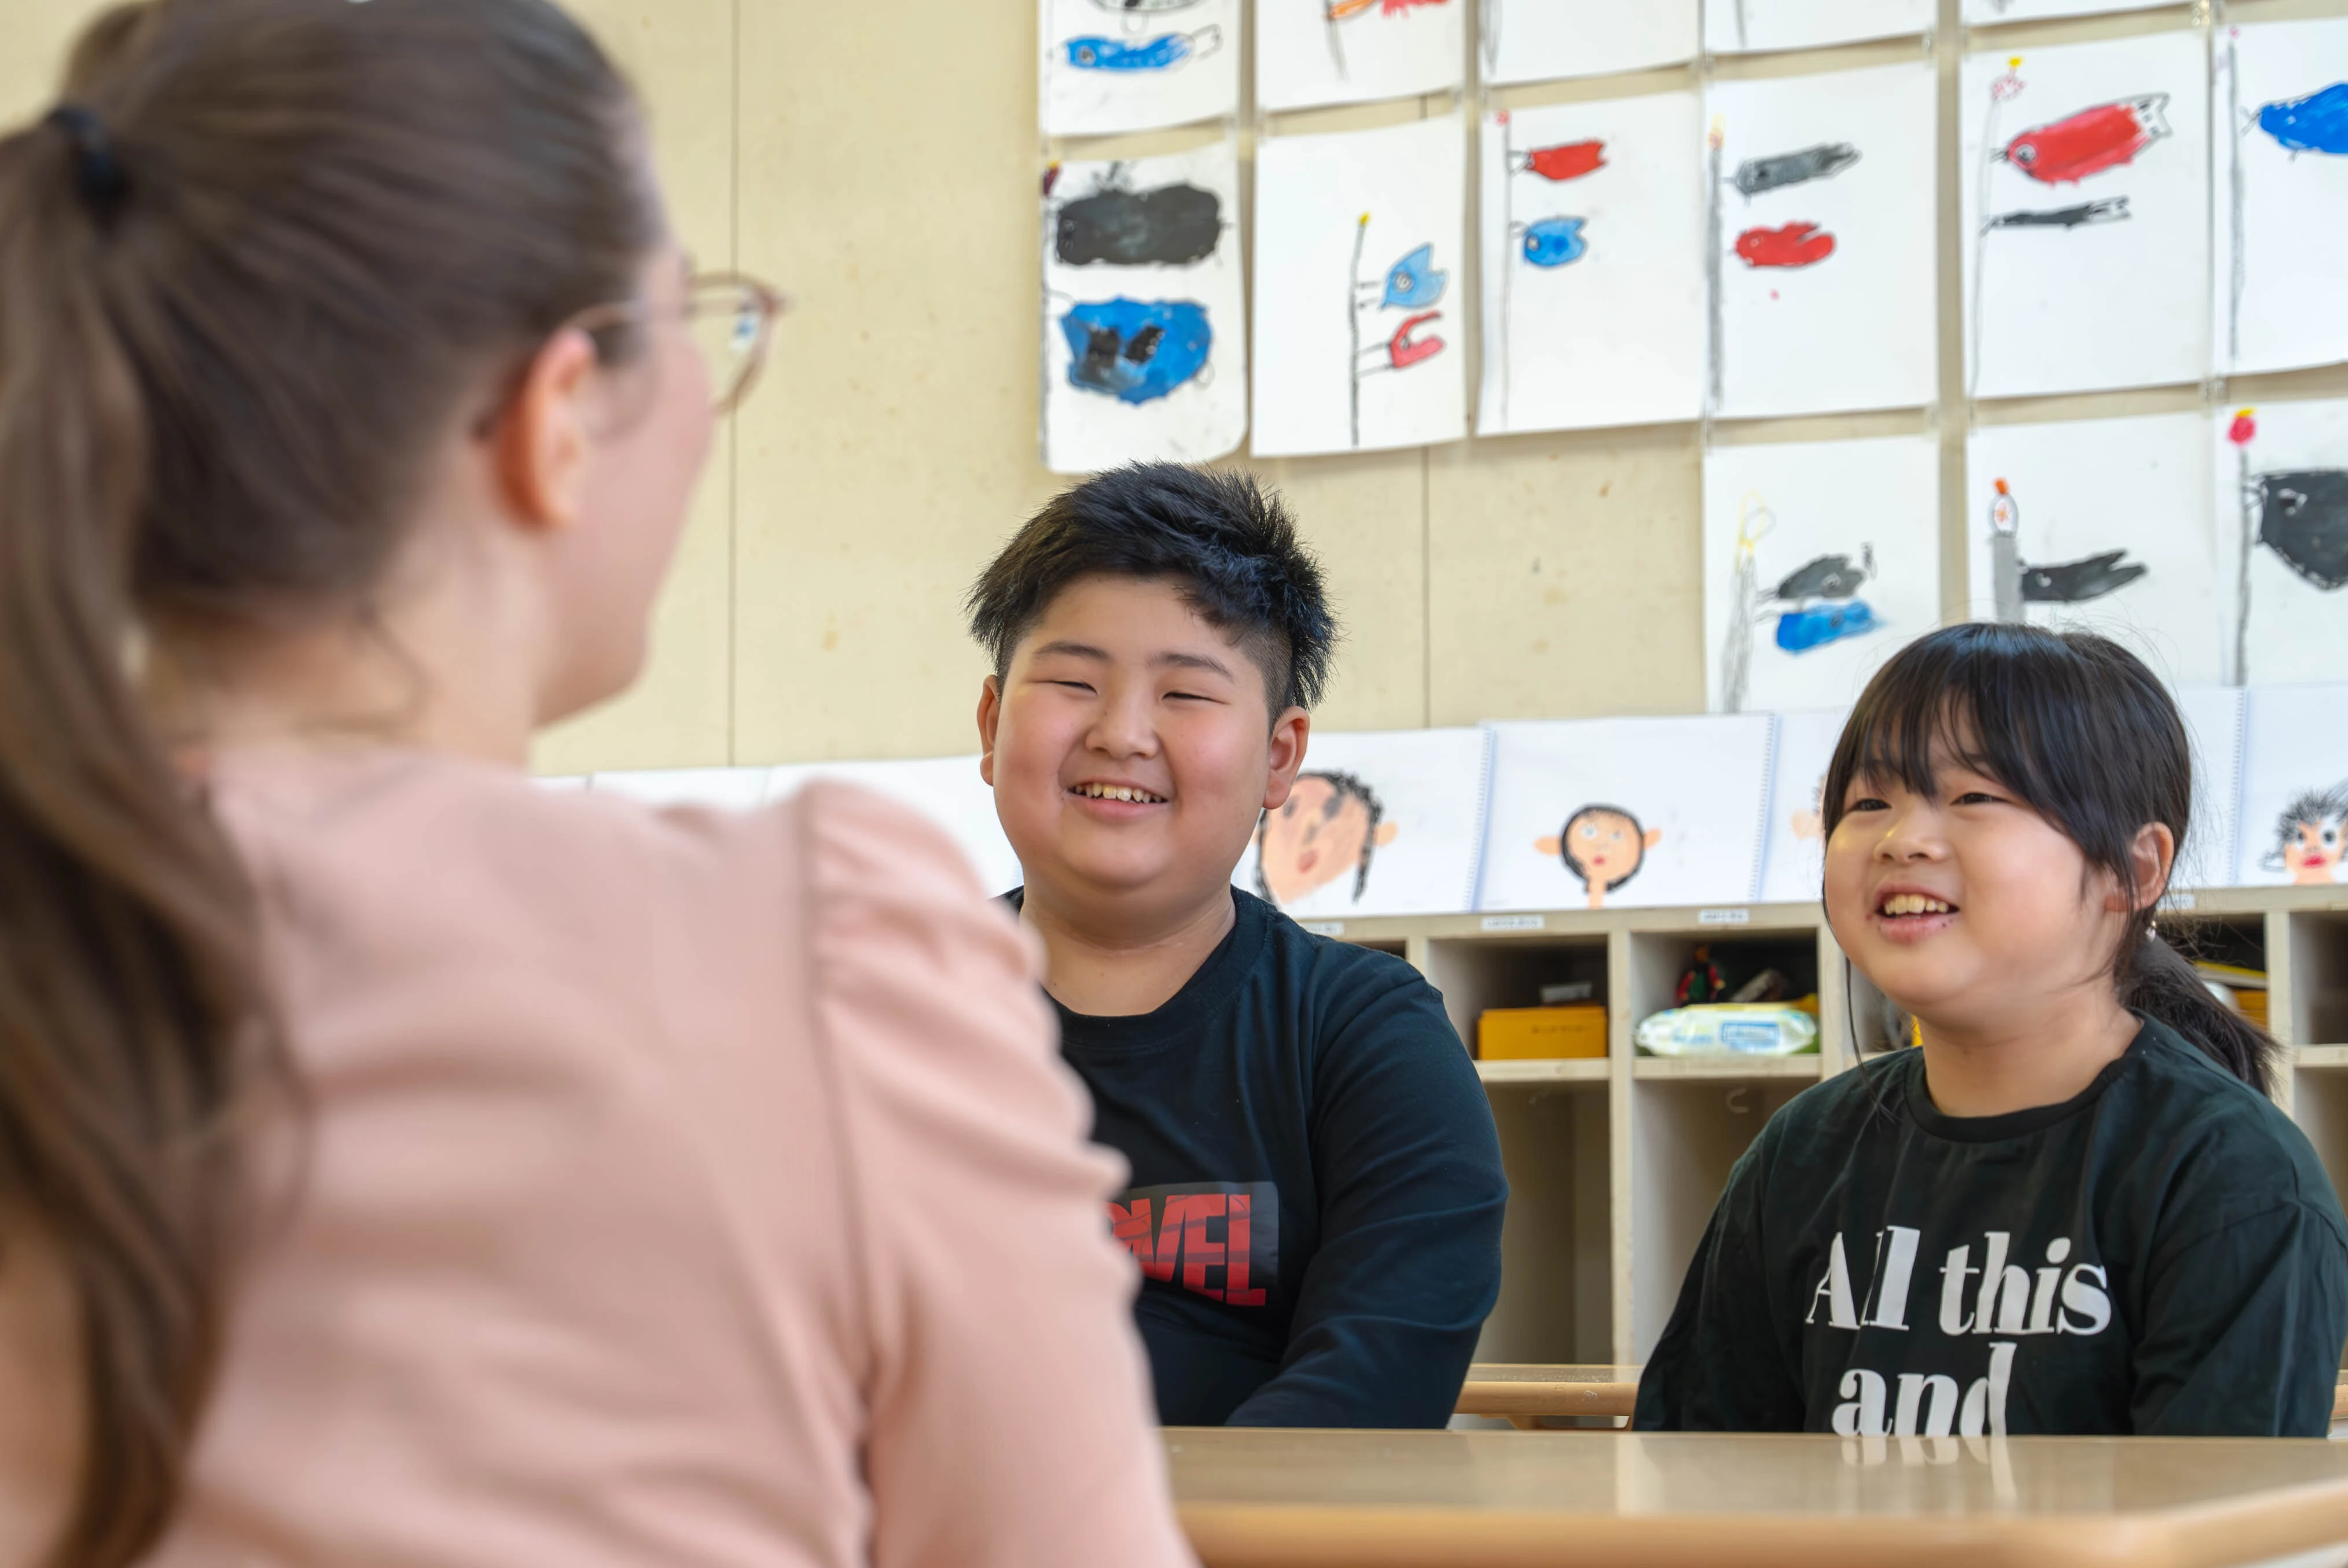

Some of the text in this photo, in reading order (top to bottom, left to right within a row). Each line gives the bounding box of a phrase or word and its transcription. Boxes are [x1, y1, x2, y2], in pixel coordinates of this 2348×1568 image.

[1805, 1225, 2112, 1336] Al this
[1831, 1341, 2018, 1438] and
